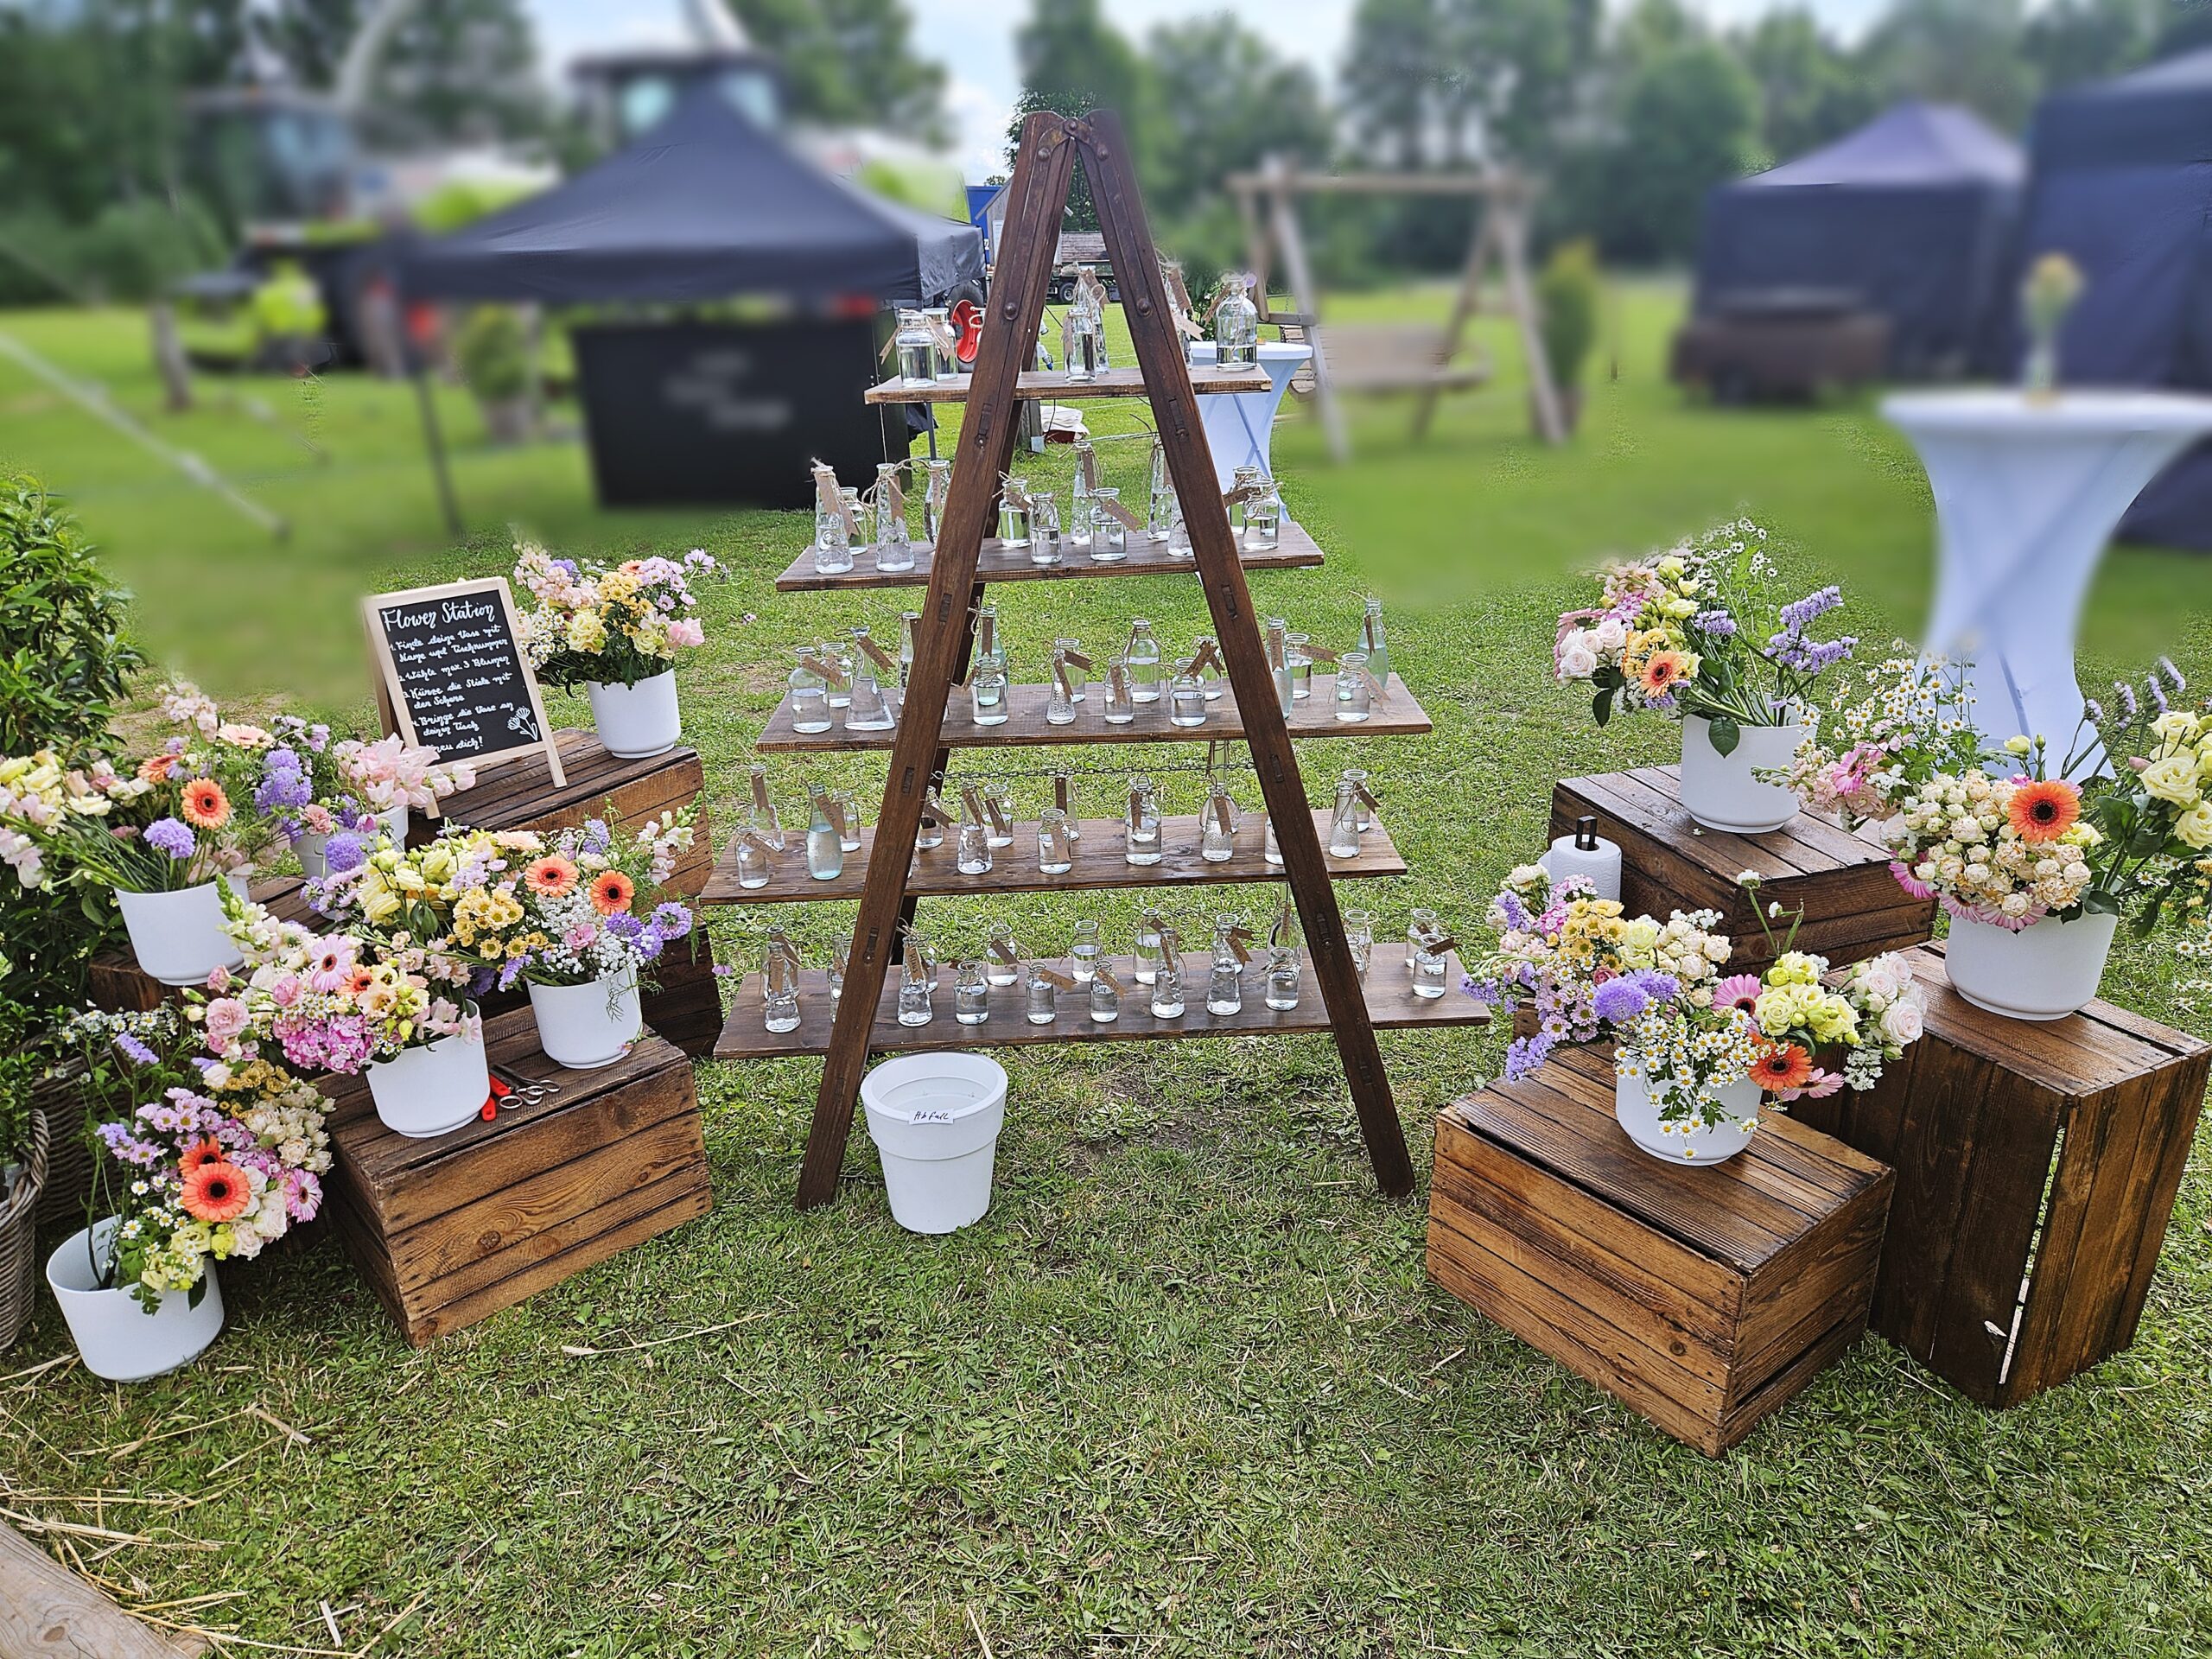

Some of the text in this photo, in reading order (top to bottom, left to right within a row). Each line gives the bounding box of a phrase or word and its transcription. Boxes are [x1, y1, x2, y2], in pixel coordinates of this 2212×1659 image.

[382, 601, 495, 632] Flower Station
[397, 639, 423, 650] Finde
[428, 635, 454, 647] deine
[458, 630, 480, 639] Vase
[483, 624, 501, 637] mit
[399, 639, 508, 664] Name und Tischnummer
[405, 668, 436, 681] Wähle
[442, 664, 461, 677] max.
[473, 655, 510, 668] Blumen
[410, 685, 442, 699] Kürze
[448, 682, 462, 691] die
[467, 677, 490, 688] Stiele
[493, 673, 512, 686] mit
[414, 694, 465, 709] der Schere
[419, 713, 454, 728] Bringe
[458, 709, 472, 717] die
[475, 704, 496, 714] Vase
[500, 702, 513, 710] an
[423, 721, 480, 736] deinen Tisch
[426, 735, 483, 753] reu dich!
[909, 952, 919, 973] Klaus
